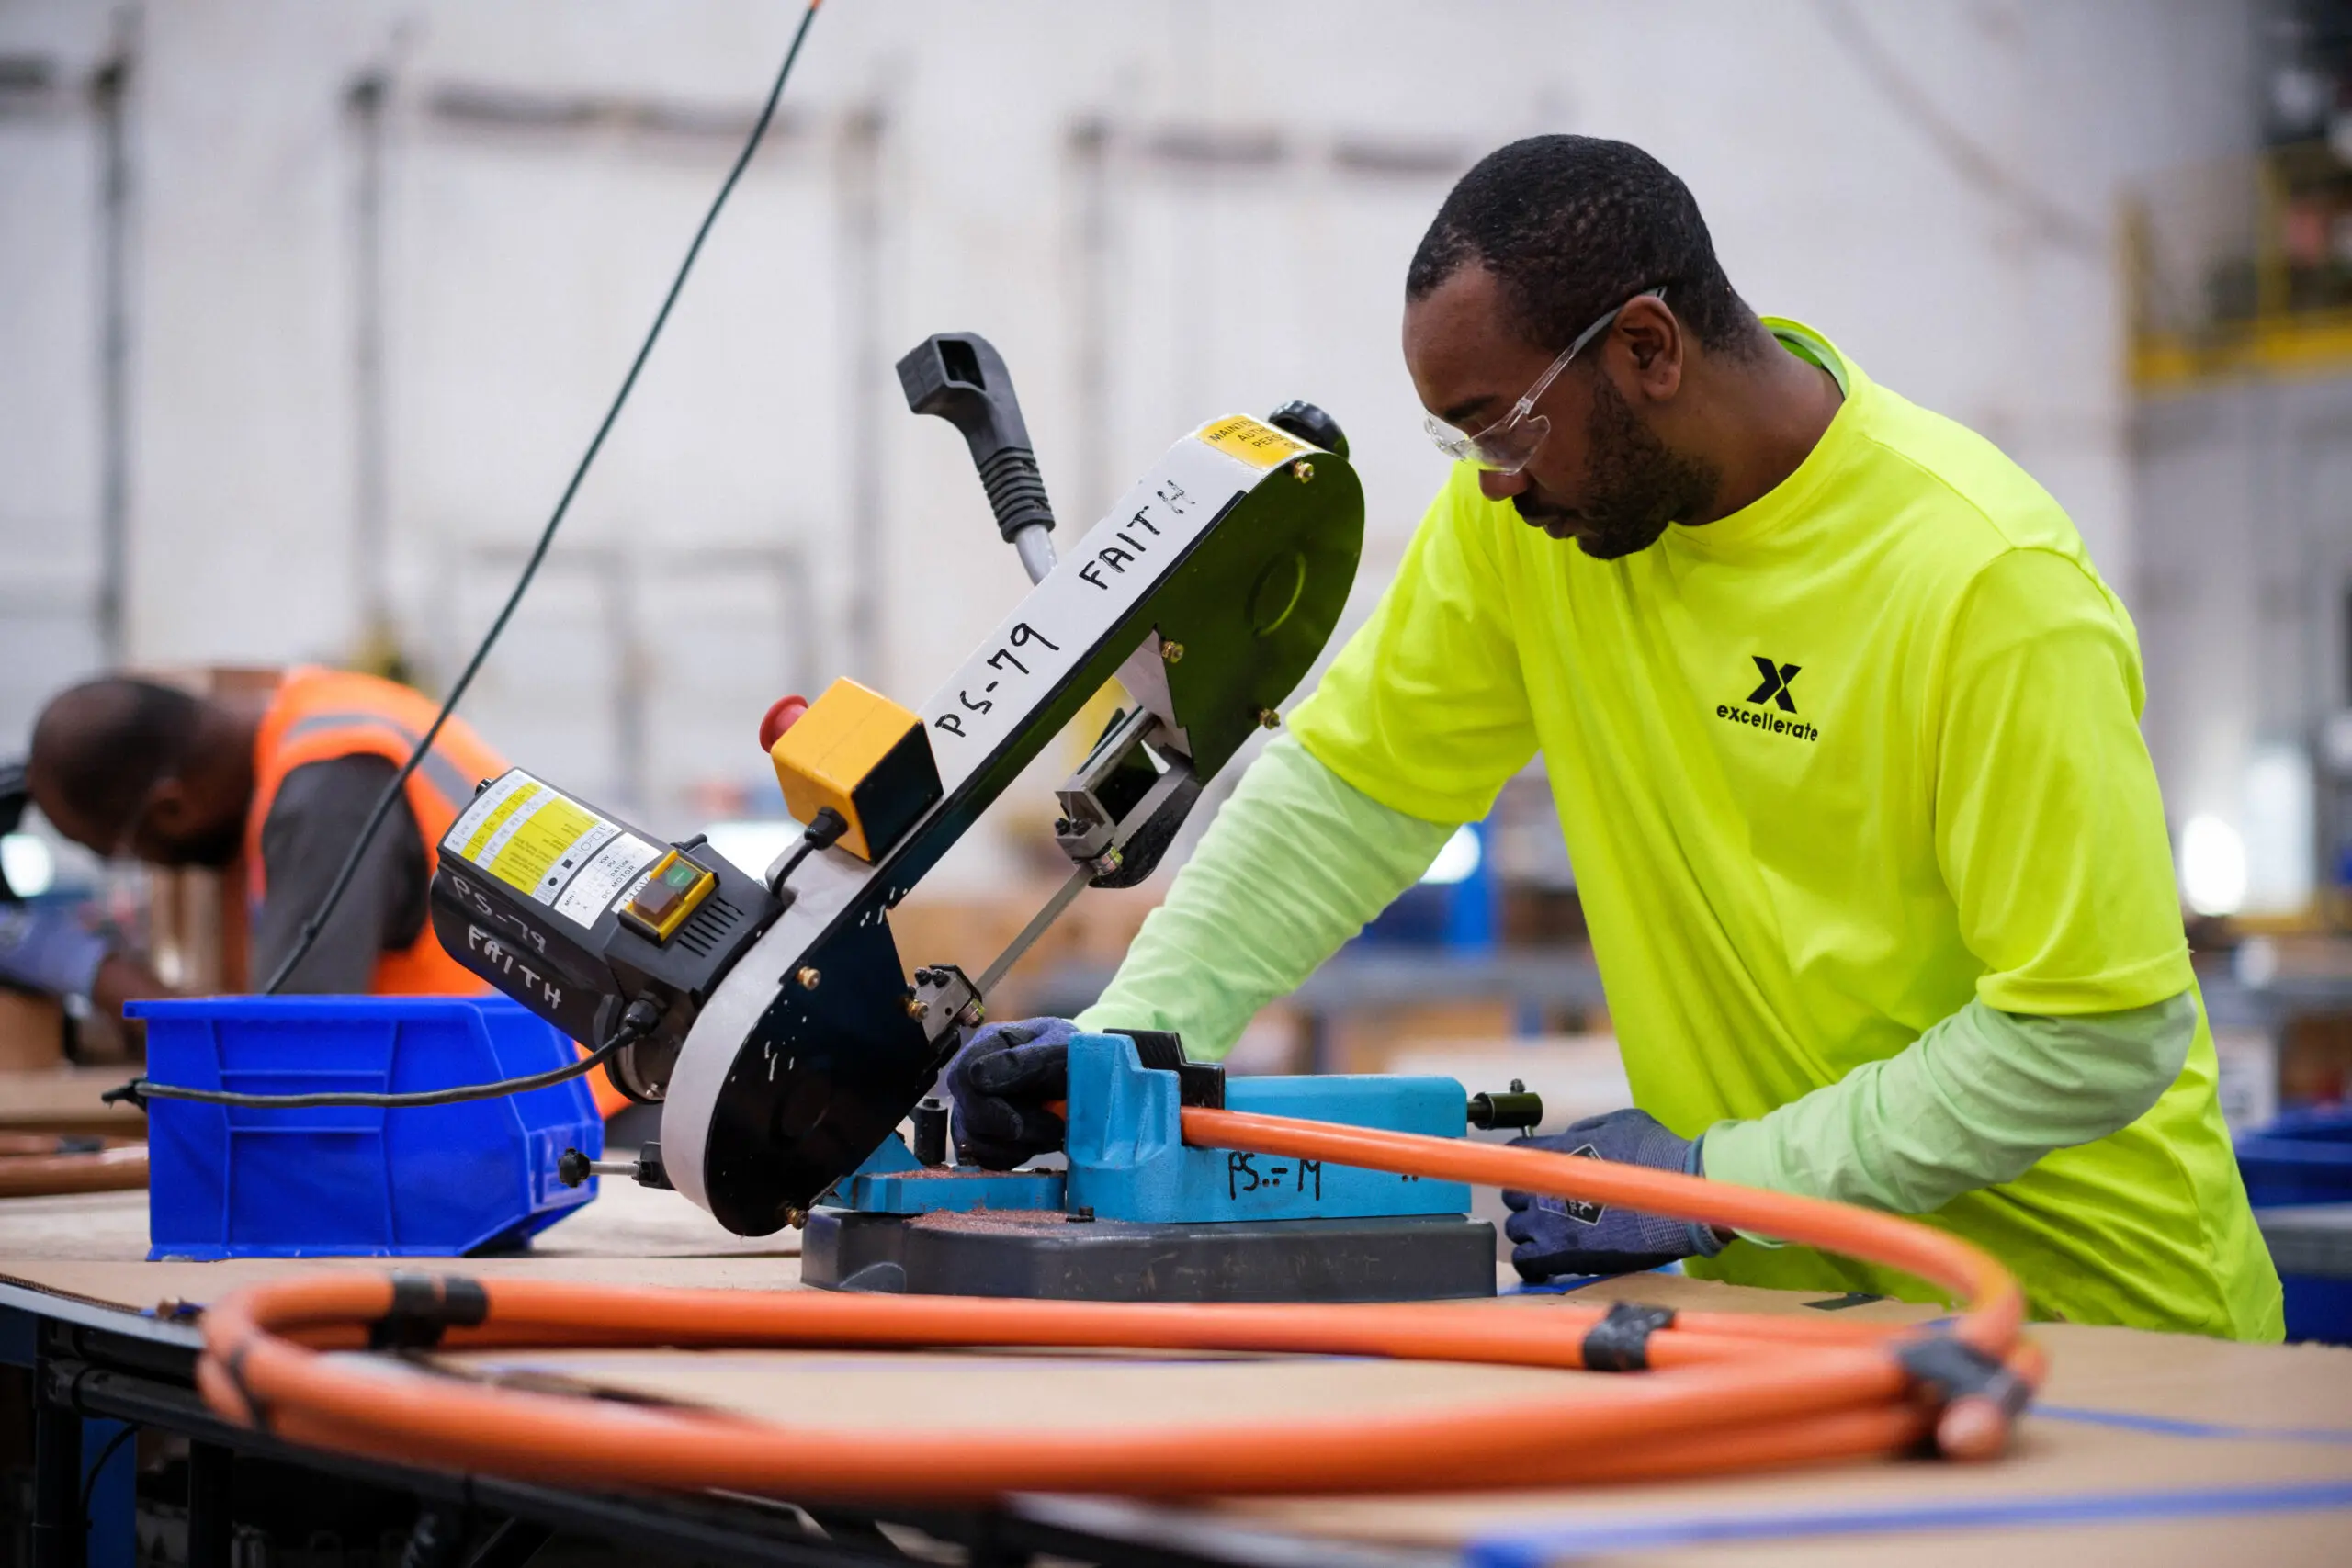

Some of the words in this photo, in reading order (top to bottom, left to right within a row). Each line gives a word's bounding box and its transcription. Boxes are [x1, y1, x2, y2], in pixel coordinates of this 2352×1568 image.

[934, 622, 1060, 738] PS-79
[1079, 479, 1196, 590] FAITH
[1716, 705, 1818, 742] excellerate
[452, 875, 547, 953] PS-79
[611, 865, 636, 888] MOTOR
[469, 924, 562, 1010] FAITH
